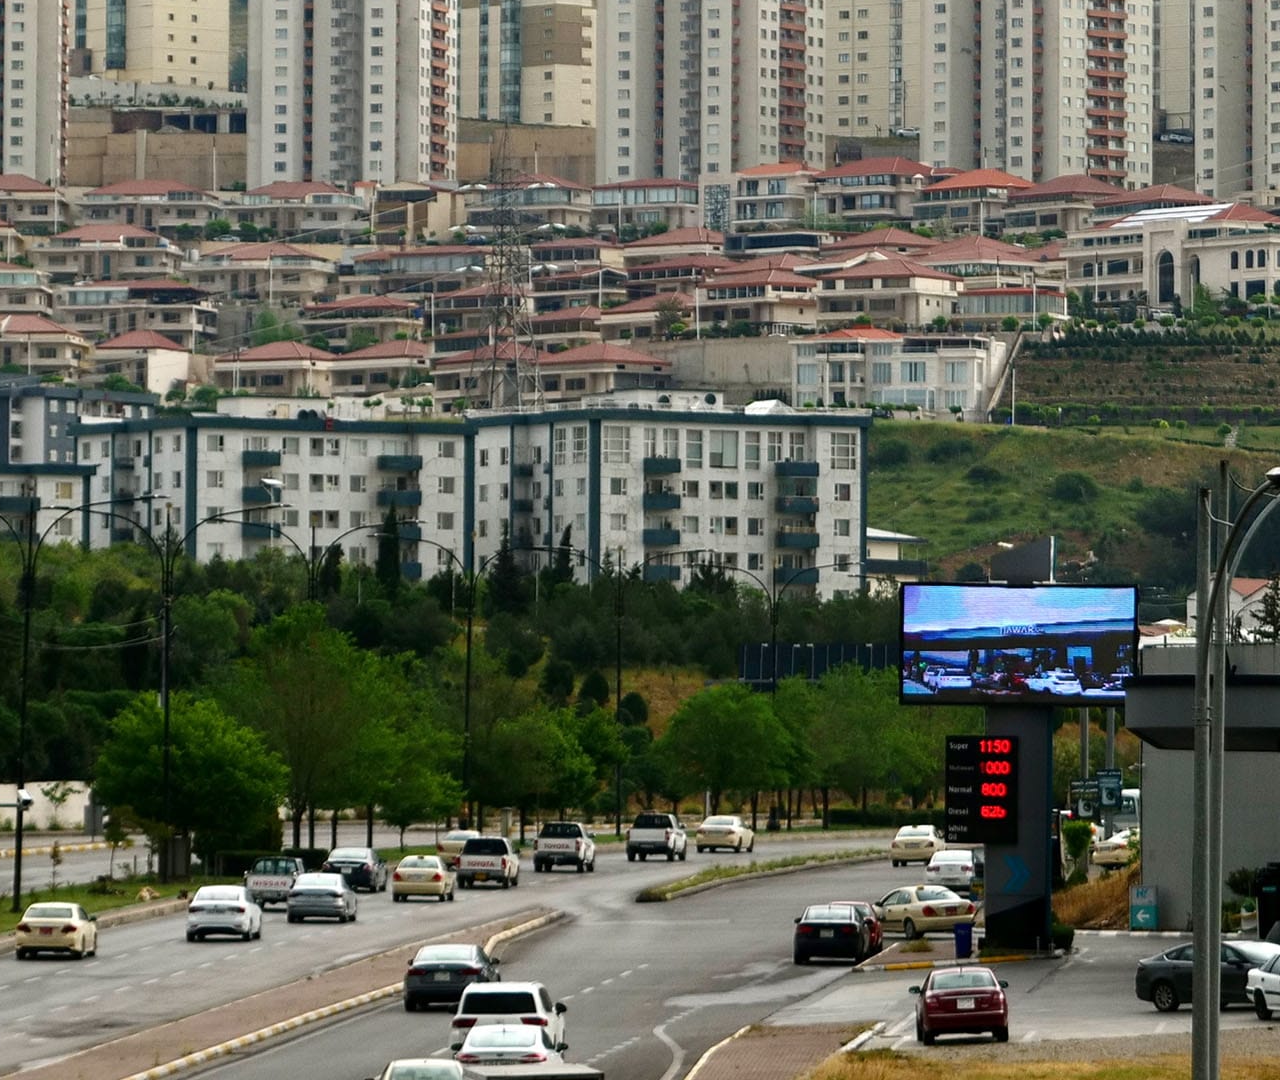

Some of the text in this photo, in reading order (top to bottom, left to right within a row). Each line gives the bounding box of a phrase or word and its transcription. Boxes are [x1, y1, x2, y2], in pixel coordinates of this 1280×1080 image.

[949, 739, 1011, 753] Super 1150
[948, 782, 1007, 797] Normal 800
[948, 807, 969, 815] Diesel
[252, 879, 288, 887] NISSAN
